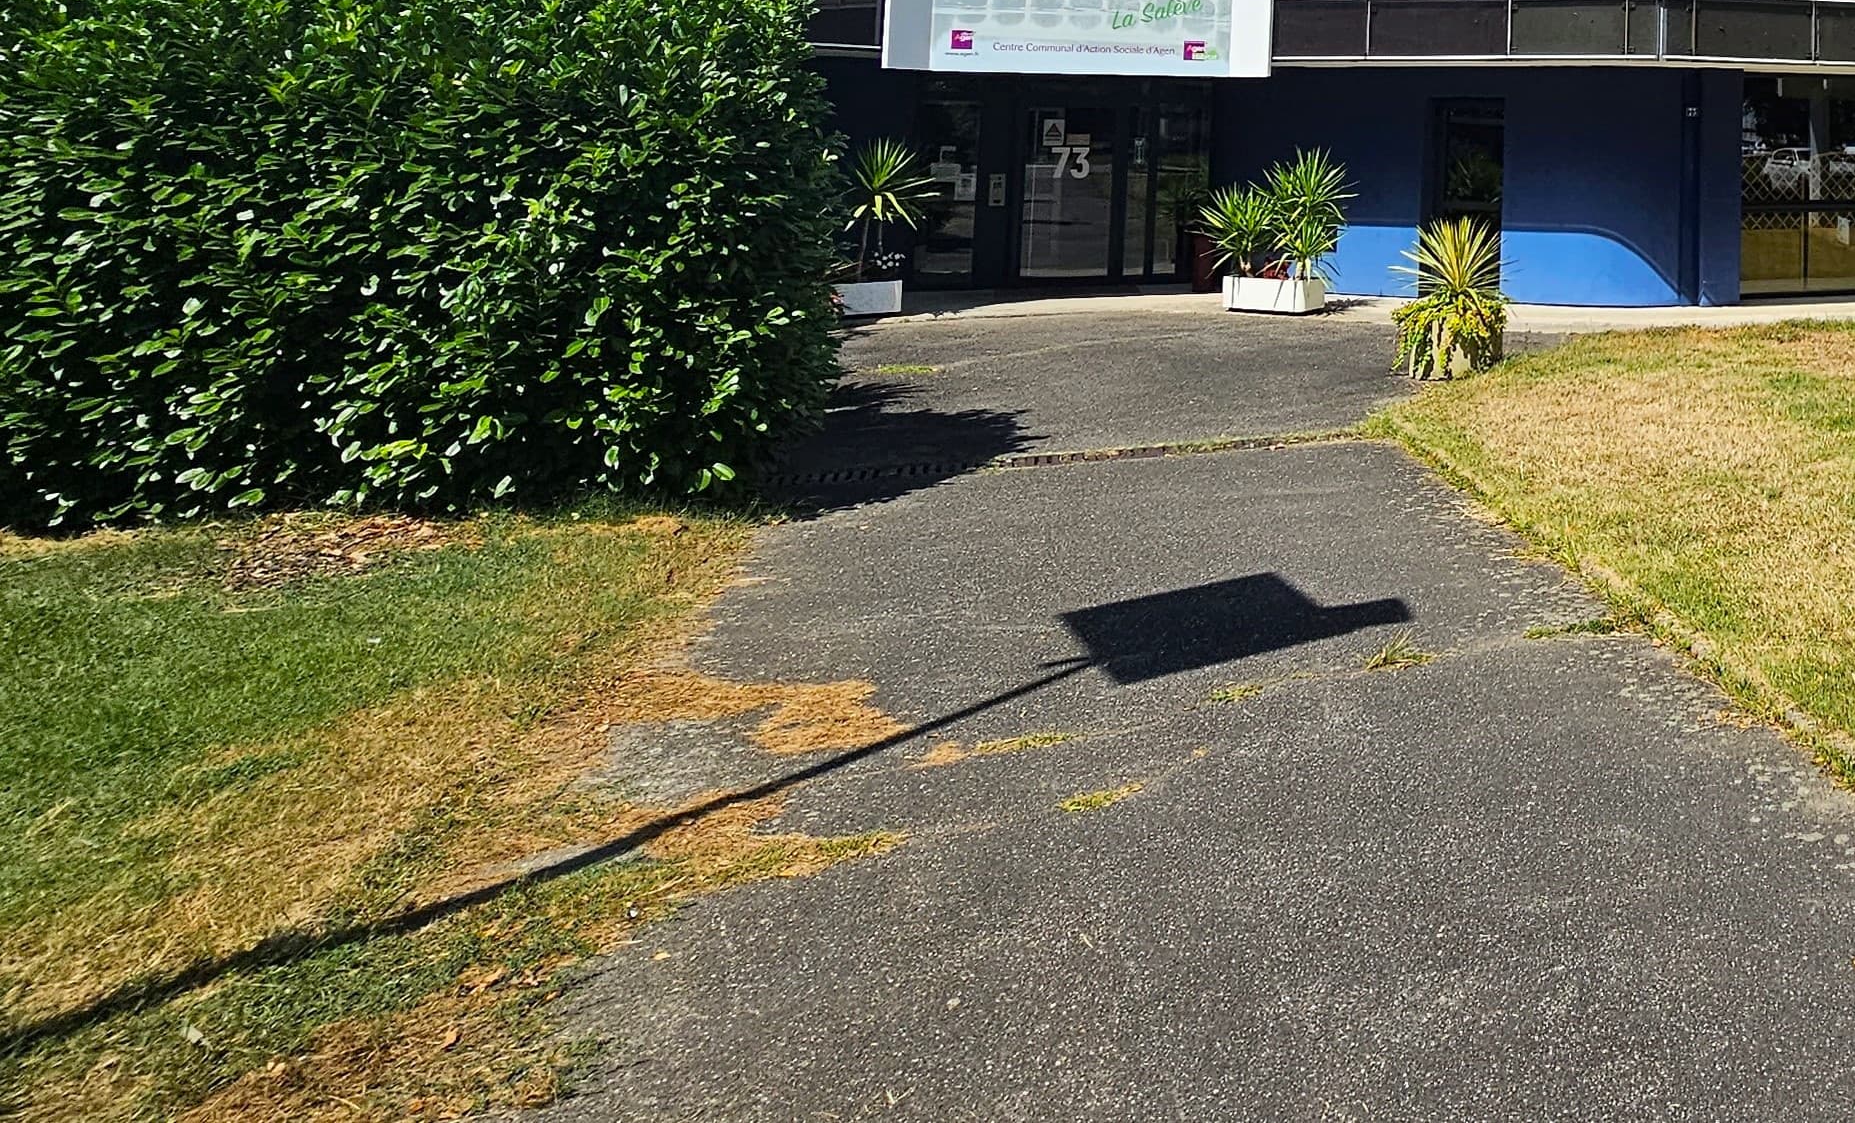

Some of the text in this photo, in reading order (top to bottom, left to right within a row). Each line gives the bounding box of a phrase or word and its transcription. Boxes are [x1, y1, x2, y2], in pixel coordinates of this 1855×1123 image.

[1112, 11, 1136, 30] La
[992, 42, 1176, 57] Centre Communal d'Action Sociale d'Agen
[1051, 146, 1090, 179] 73
